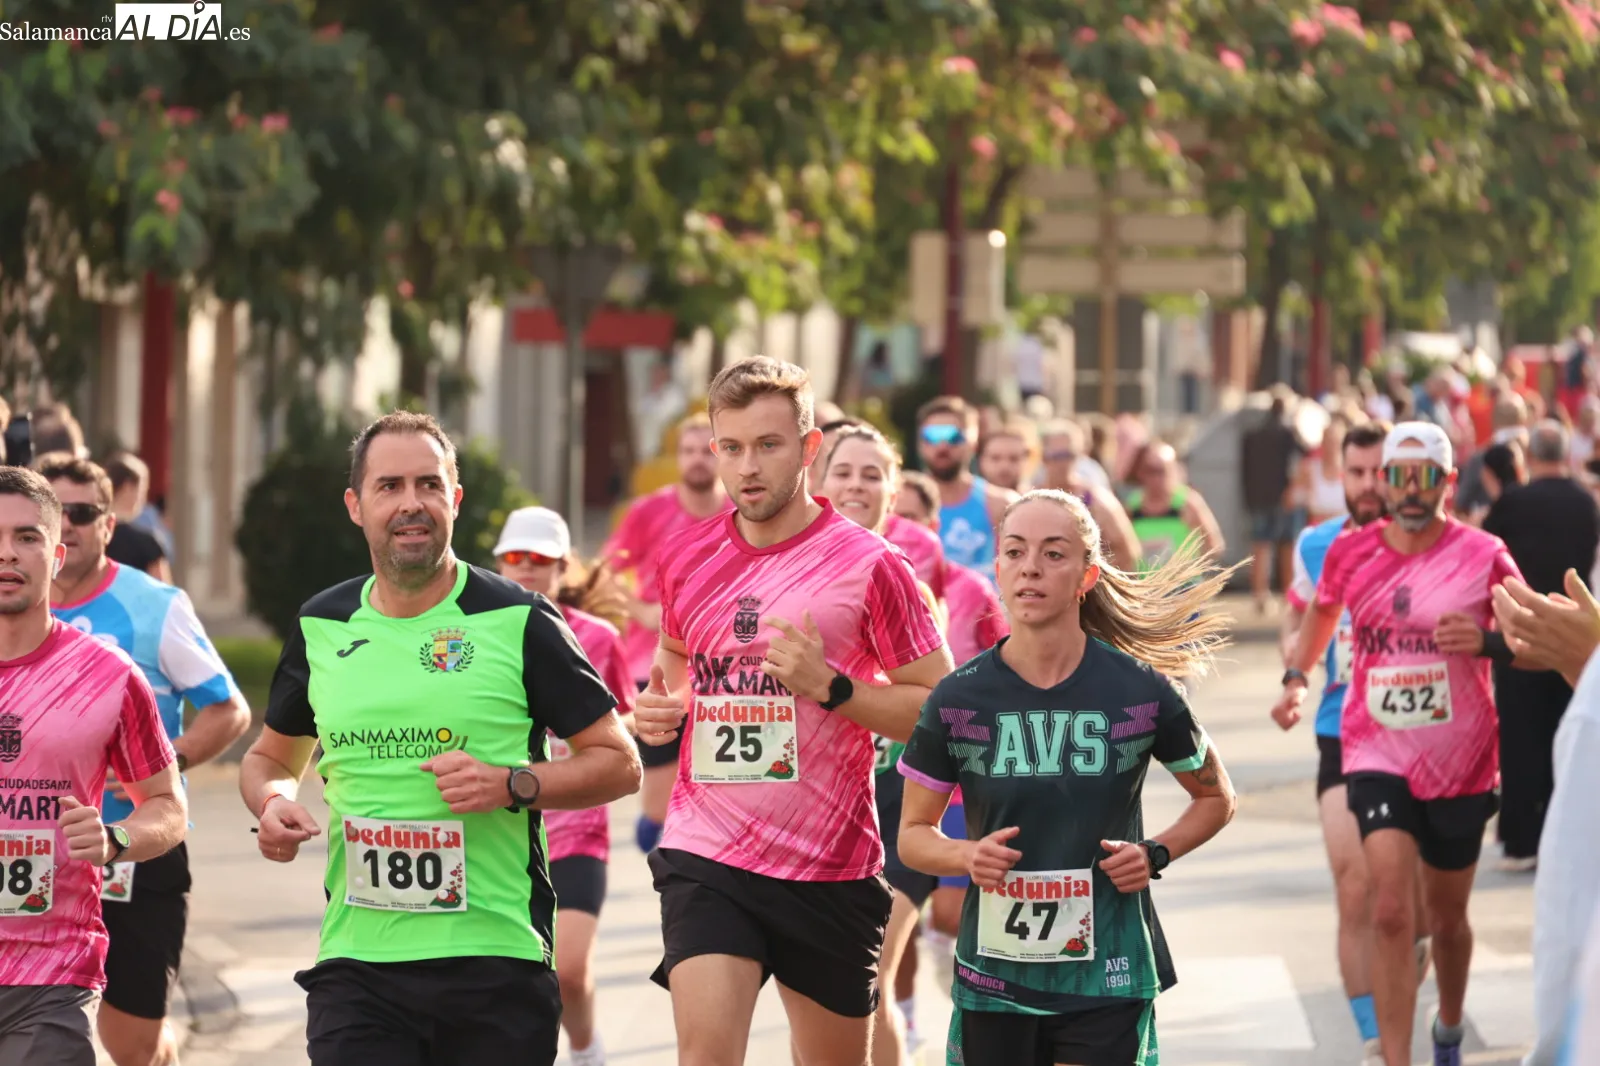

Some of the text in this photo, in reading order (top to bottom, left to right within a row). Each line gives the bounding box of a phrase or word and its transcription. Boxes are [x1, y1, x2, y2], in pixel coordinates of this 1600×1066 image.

[695, 701, 793, 722] bedunia
[1381, 685, 1436, 714] 432
[329, 727, 452, 748] SANMAXIMO
[715, 725, 762, 762] 25
[990, 709, 1109, 777] AVS
[367, 743, 443, 760] TELECOM
[344, 820, 461, 849] bedunia
[363, 849, 442, 890] 180
[983, 875, 1090, 899] edunia
[1005, 902, 1059, 940] 47
[1105, 956, 1129, 973] AVS
[1105, 973, 1131, 989] 1990
